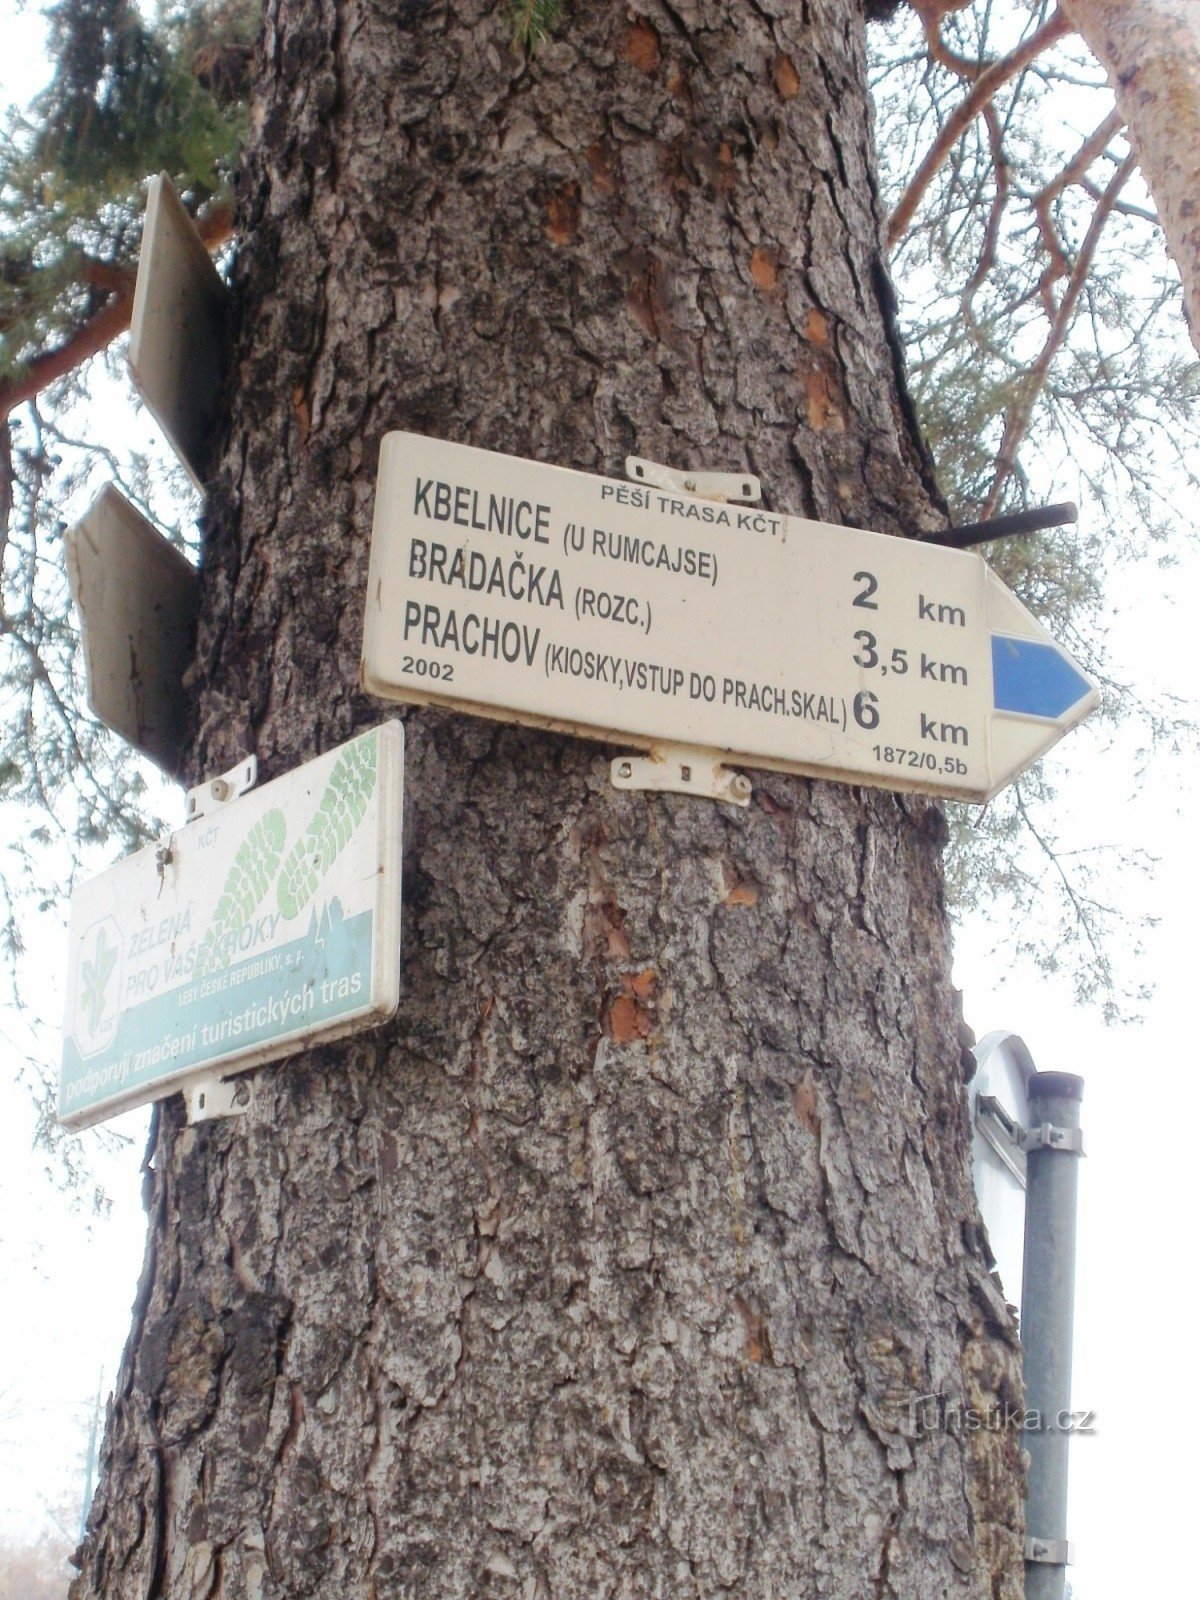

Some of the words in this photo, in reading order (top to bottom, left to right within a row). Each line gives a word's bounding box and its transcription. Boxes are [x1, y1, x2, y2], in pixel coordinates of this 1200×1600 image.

[601, 484, 650, 510] PĚŠÍ
[656, 496, 731, 526] TRASA
[737, 513, 780, 535] KČT
[413, 477, 550, 544] KBELNICE
[563, 523, 584, 556] (U
[593, 529, 718, 586] RUMCAJSE)
[852, 571, 879, 610] 2
[918, 594, 966, 627] km
[409, 538, 564, 610] BRADAČKA
[575, 587, 651, 634] (ROZC.)
[853, 630, 908, 675] 3,5
[920, 653, 968, 686] km
[402, 656, 454, 681] 2002
[403, 600, 540, 666] PRACHOV
[690, 672, 716, 702] DO
[723, 678, 847, 732] PRACH.SKAL)
[853, 690, 880, 729] 6
[920, 713, 968, 746] km
[872, 745, 968, 776] 1872/0,5b
[198, 825, 220, 850] KČT
[125, 963, 159, 1003] PRO
[163, 939, 209, 982] VAŠE
[212, 912, 281, 962] KROKY
[127, 900, 193, 960] ZELENÁ
[178, 985, 198, 1007] LESY
[200, 970, 228, 998] ČESKÉ
[65, 1049, 132, 1106] podporují
[133, 1023, 198, 1073] značení
[201, 983, 314, 1046] turistických
[320, 971, 362, 1004] tras
